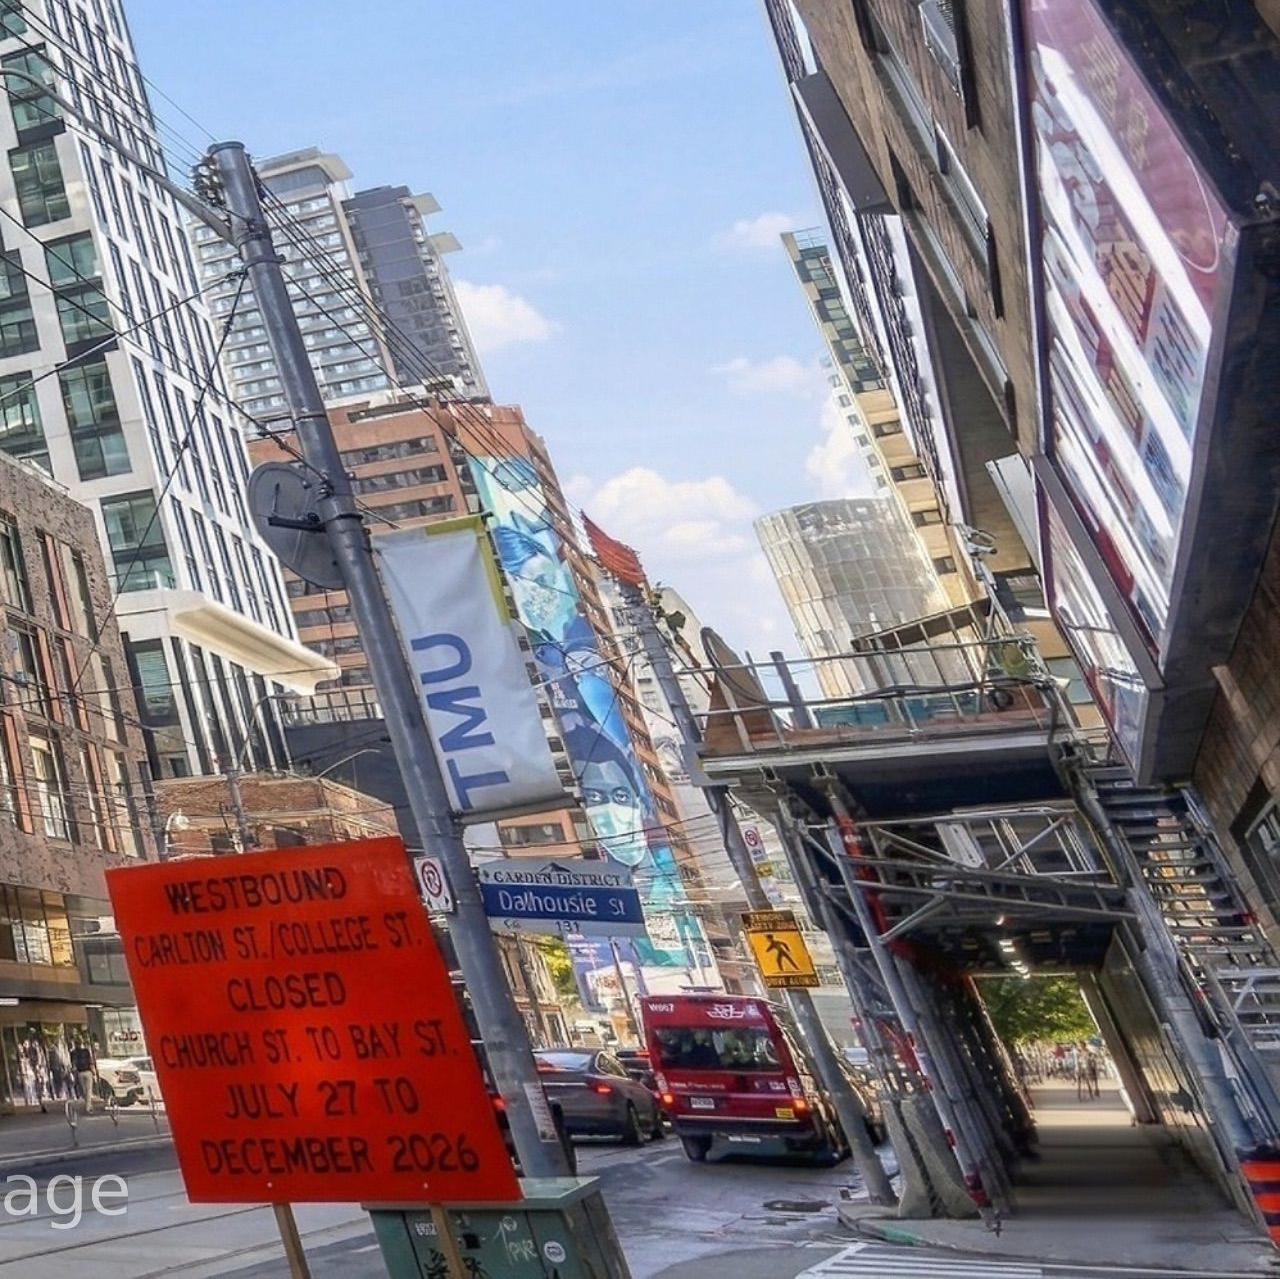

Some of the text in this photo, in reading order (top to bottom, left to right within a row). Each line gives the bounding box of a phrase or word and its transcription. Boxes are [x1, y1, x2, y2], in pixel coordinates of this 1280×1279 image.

[410, 632, 511, 810] TMU
[164, 866, 348, 915] WESTBOUND
[556, 872, 621, 886] DISTRICT
[498, 889, 626, 916] Dalhousie St
[134, 930, 227, 968] CARLTON
[385, 911, 424, 947] ST.
[226, 971, 347, 1013] CLOSED
[159, 1031, 251, 1069] CHURCH
[262, 1028, 303, 1065] ST.
[306, 1025, 341, 1061] TO
[351, 1023, 401, 1060] BAY
[413, 1020, 459, 1057] ST.
[225, 1075, 420, 1120] JULY 27 TO
[200, 1133, 481, 1176] DECEMBER 2026
